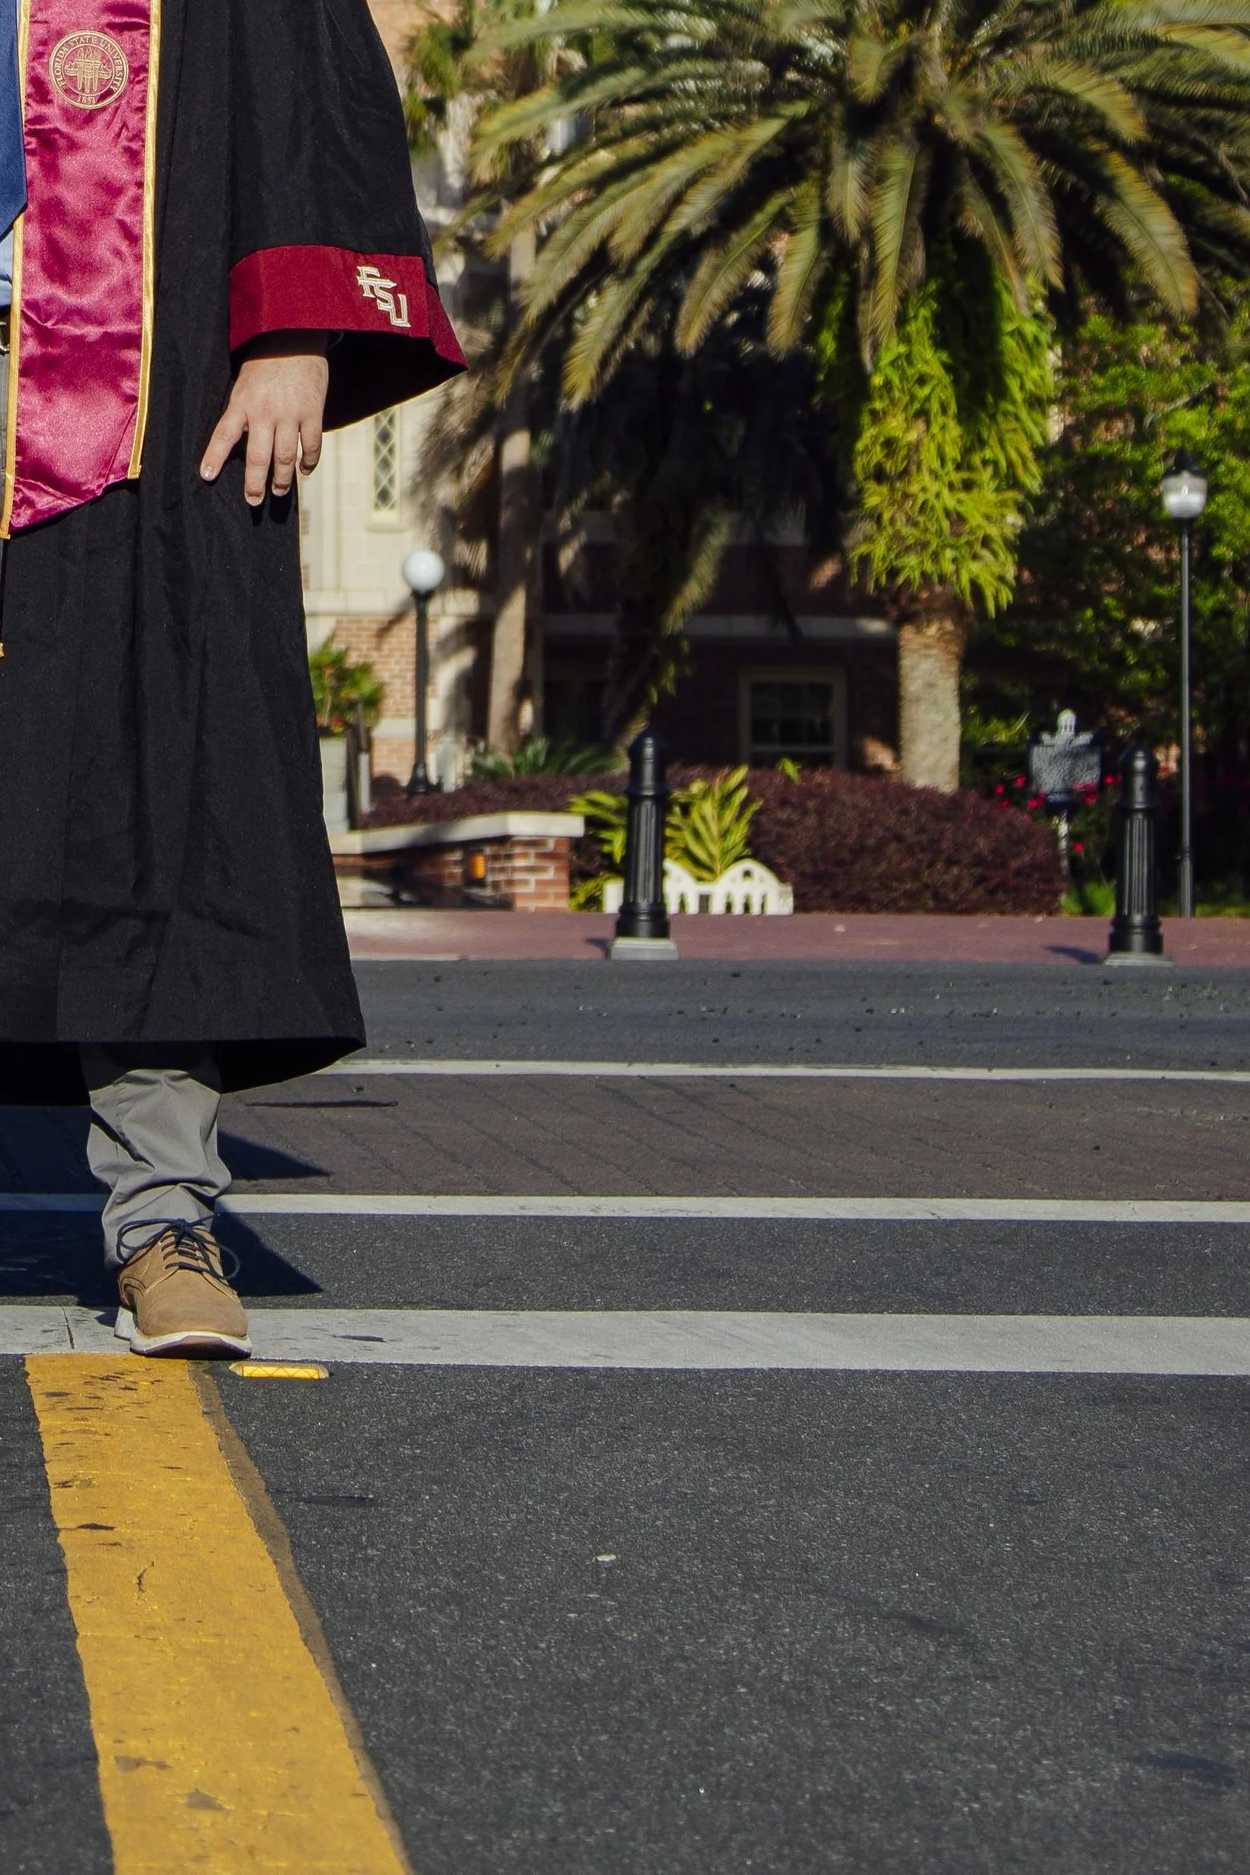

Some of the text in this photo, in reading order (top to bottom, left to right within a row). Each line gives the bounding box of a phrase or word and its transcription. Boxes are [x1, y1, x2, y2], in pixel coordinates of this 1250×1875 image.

[54, 35, 123, 93] FLORIDA STATE UNIVERSITY
[77, 96, 97, 105] 1851
[356, 266, 411, 328] FSU
